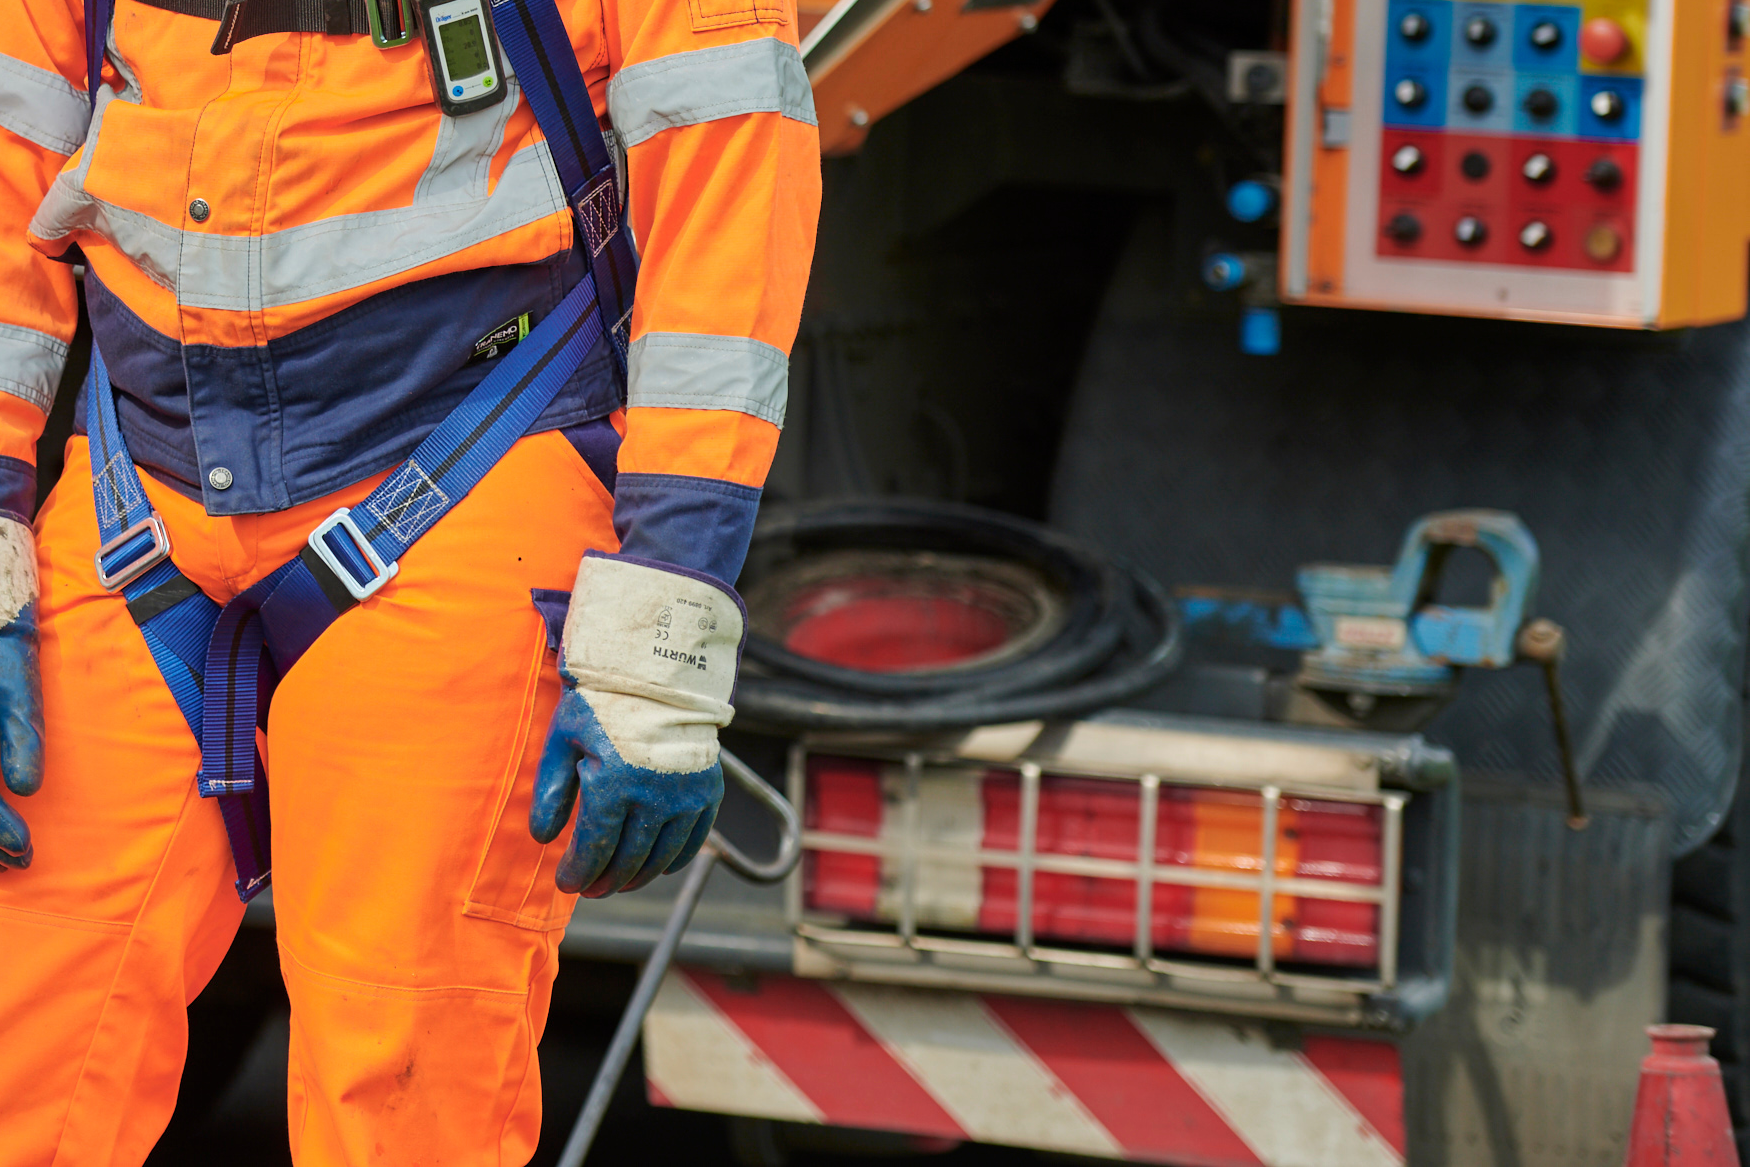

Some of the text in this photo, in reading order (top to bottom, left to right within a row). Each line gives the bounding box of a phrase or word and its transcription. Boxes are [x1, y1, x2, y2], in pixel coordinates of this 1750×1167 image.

[476, 325, 518, 350] TRANEMO
[676, 597, 688, 605] 420
[653, 646, 697, 666] WÜRTH
